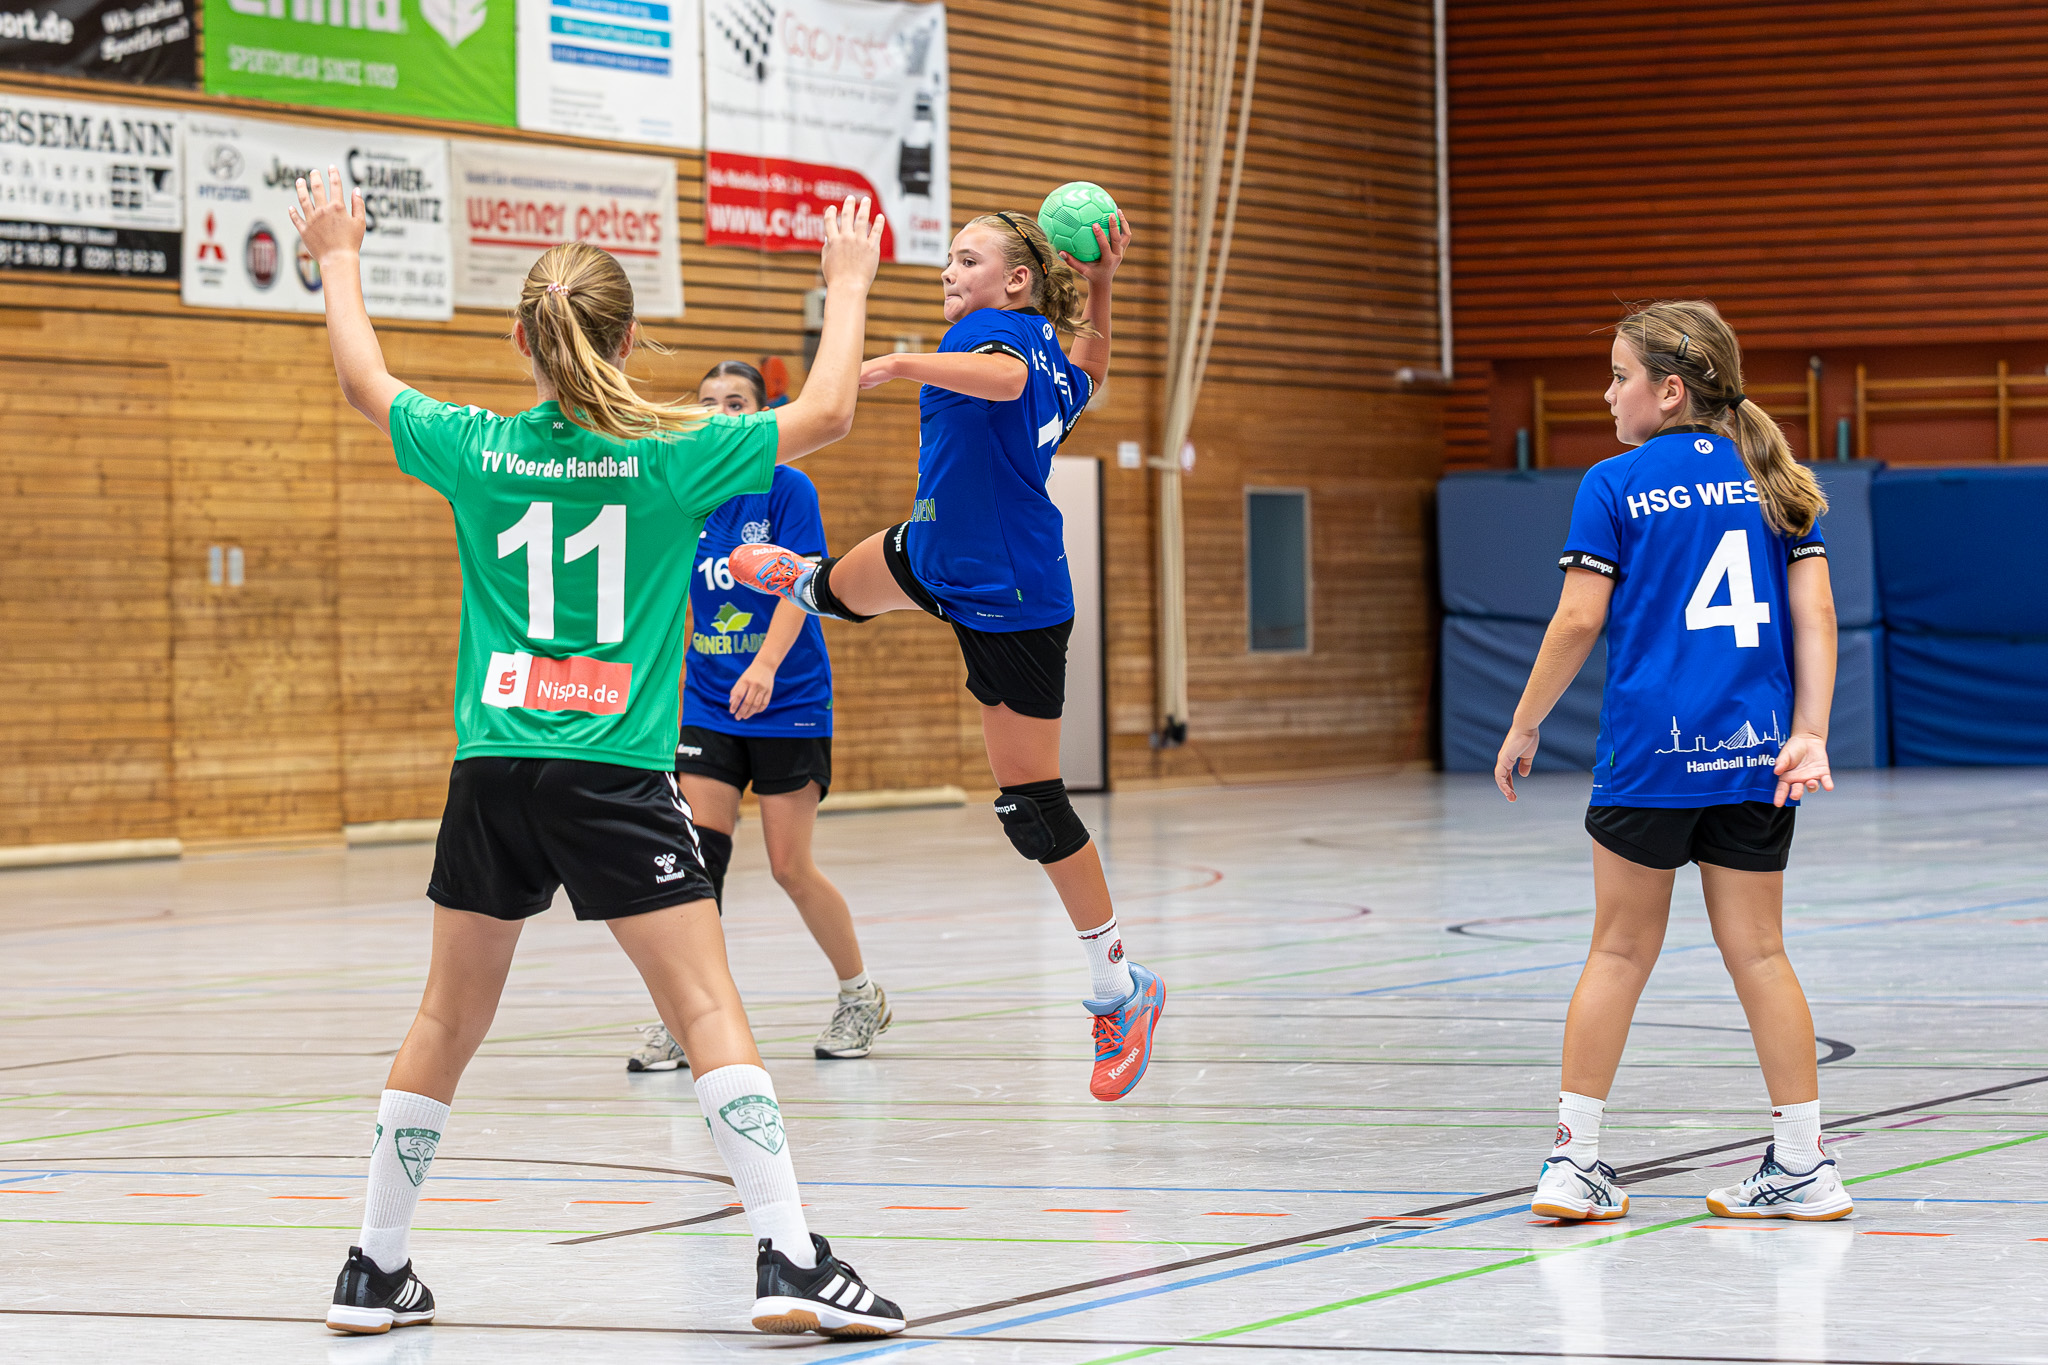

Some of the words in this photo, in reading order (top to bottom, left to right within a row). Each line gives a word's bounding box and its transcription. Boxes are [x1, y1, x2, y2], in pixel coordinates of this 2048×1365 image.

[0, 9, 74, 45] ort.de
[228, 44, 319, 80] SPORTSWEAR
[322, 57, 361, 86] SINCE
[466, 196, 565, 237] werner
[574, 200, 662, 244] peters
[481, 450, 503, 473] TV
[506, 453, 564, 478] Voerde
[566, 456, 639, 479] Handball
[909, 498, 936, 523] ADEN
[1627, 485, 1692, 519] HSG
[1580, 554, 1614, 574] Kempa
[1792, 546, 1825, 558] Kempa
[497, 501, 628, 644] 11
[698, 557, 735, 592] 16
[1685, 529, 1770, 648] 4
[537, 680, 619, 704] Nispa.de
[1687, 756, 1744, 773] Handball
[1746, 755, 1757, 767] in
[1758, 754, 1776, 767] We
[656, 869, 685, 884] hummel
[1107, 1047, 1140, 1080] Kempa
